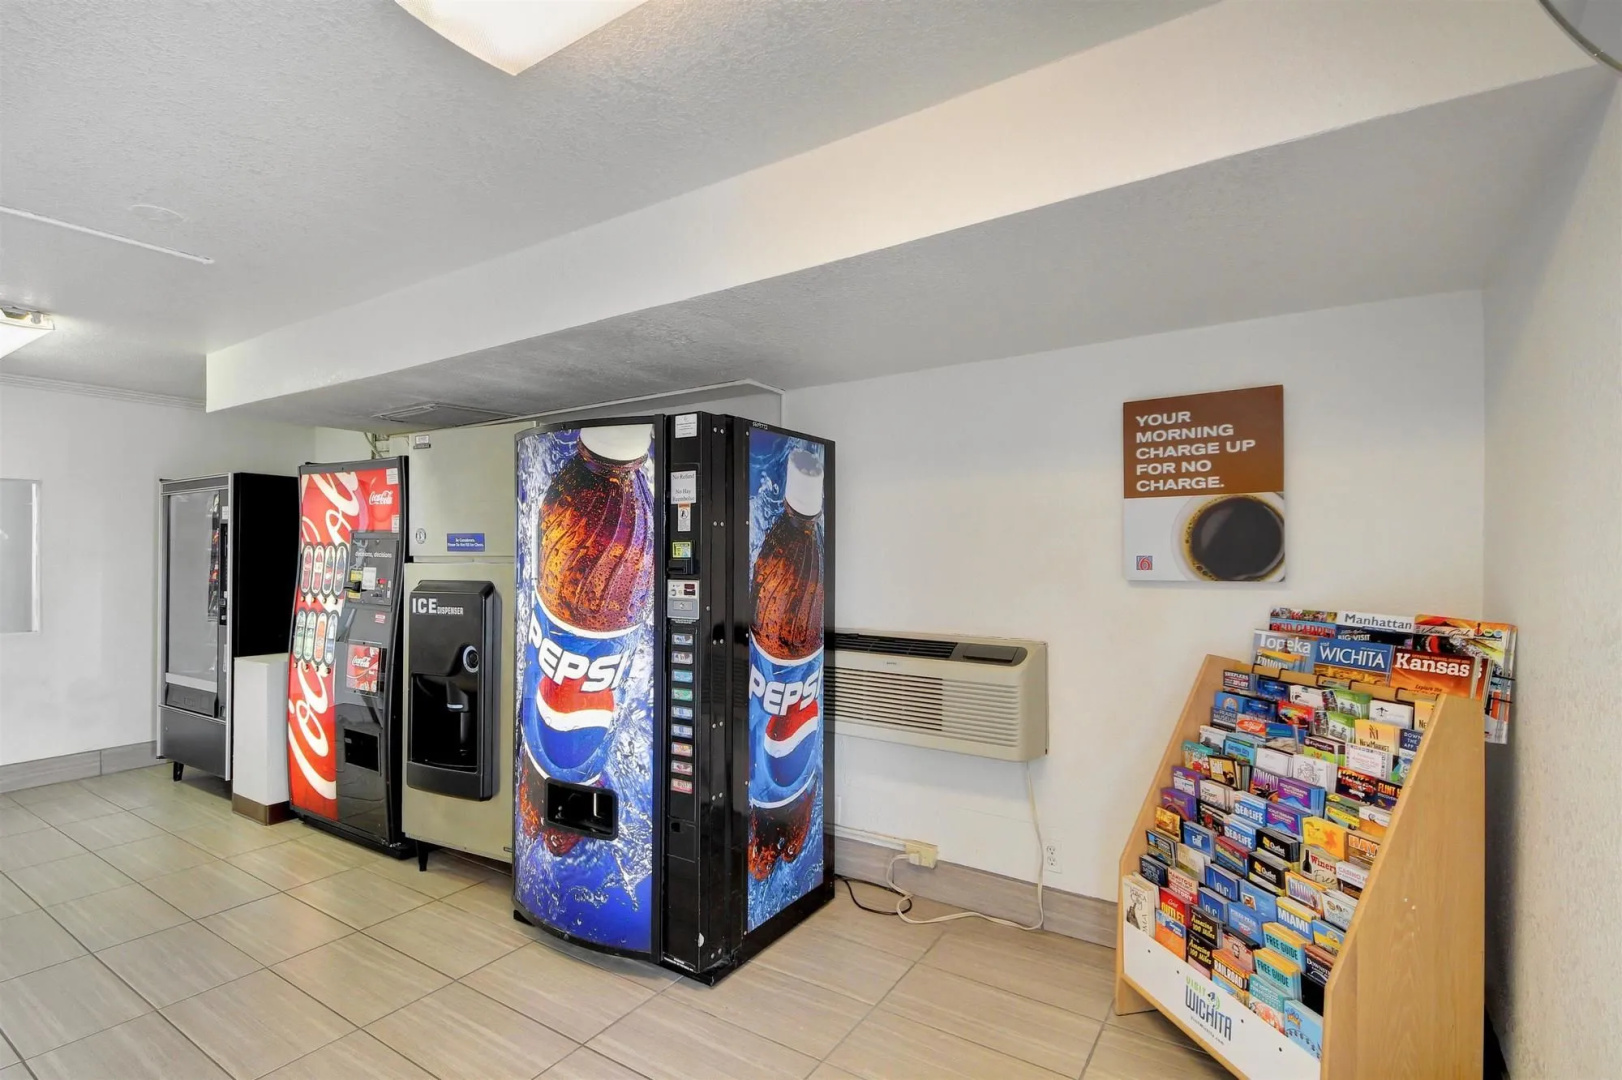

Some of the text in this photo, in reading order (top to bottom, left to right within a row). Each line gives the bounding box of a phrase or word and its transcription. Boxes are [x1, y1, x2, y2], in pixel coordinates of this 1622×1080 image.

[1135, 411, 1191, 426] YOUR
[1136, 424, 1234, 443] MORNING
[1136, 440, 1256, 459] CHARGE UP
[1136, 460, 1212, 475] FOR NO
[1136, 476, 1225, 491] CHARGE.
[412, 598, 464, 615] ICE DISPENSER
[1344, 613, 1412, 630] Manhattan
[528, 610, 629, 692] PEPSI
[1260, 634, 1311, 654] Topeka
[1320, 645, 1385, 668] WICHITA
[1395, 652, 1470, 677] Kansas
[748, 664, 823, 716] PEPSI
[1378, 783, 1396, 796] FLINT
[1235, 803, 1247, 816] SEA
[1224, 825, 1237, 840] SEA
[1161, 902, 1185, 925] OUTLET
[1278, 905, 1310, 934] MIAMI
[1265, 933, 1298, 960] FREE GUIDE
[1213, 959, 1244, 989] RAILROAD
[1257, 959, 1289, 987] FREE GUIDE
[1186, 975, 1206, 997] VISIT
[1185, 985, 1233, 1042] WICHITA
